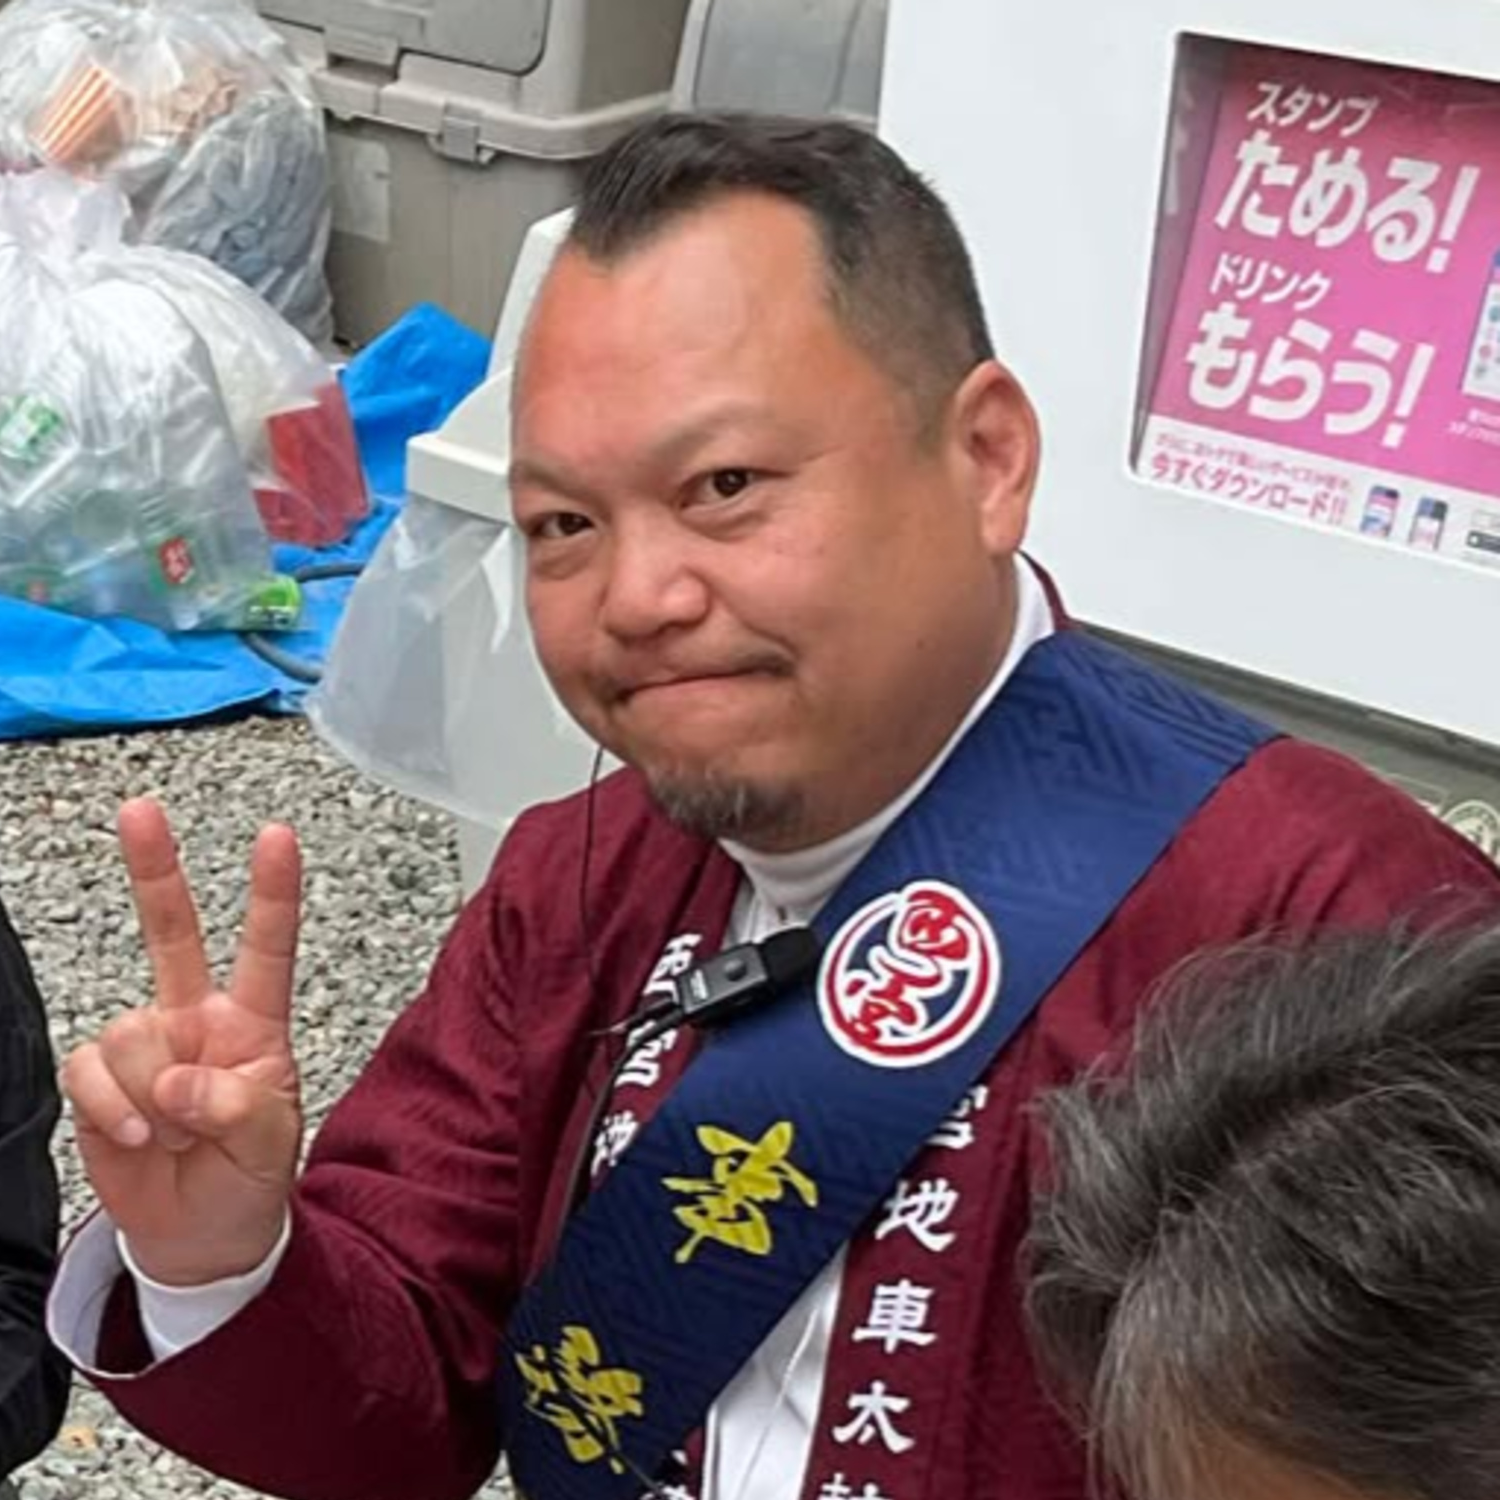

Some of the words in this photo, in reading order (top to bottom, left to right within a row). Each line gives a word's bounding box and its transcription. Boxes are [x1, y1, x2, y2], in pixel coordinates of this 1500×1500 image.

[1247, 82, 1379, 137] スタンプ
[1214, 129, 1480, 273] ためる!
[1210, 252, 1331, 311] ドリンク
[1185, 301, 1436, 449] もらう!
